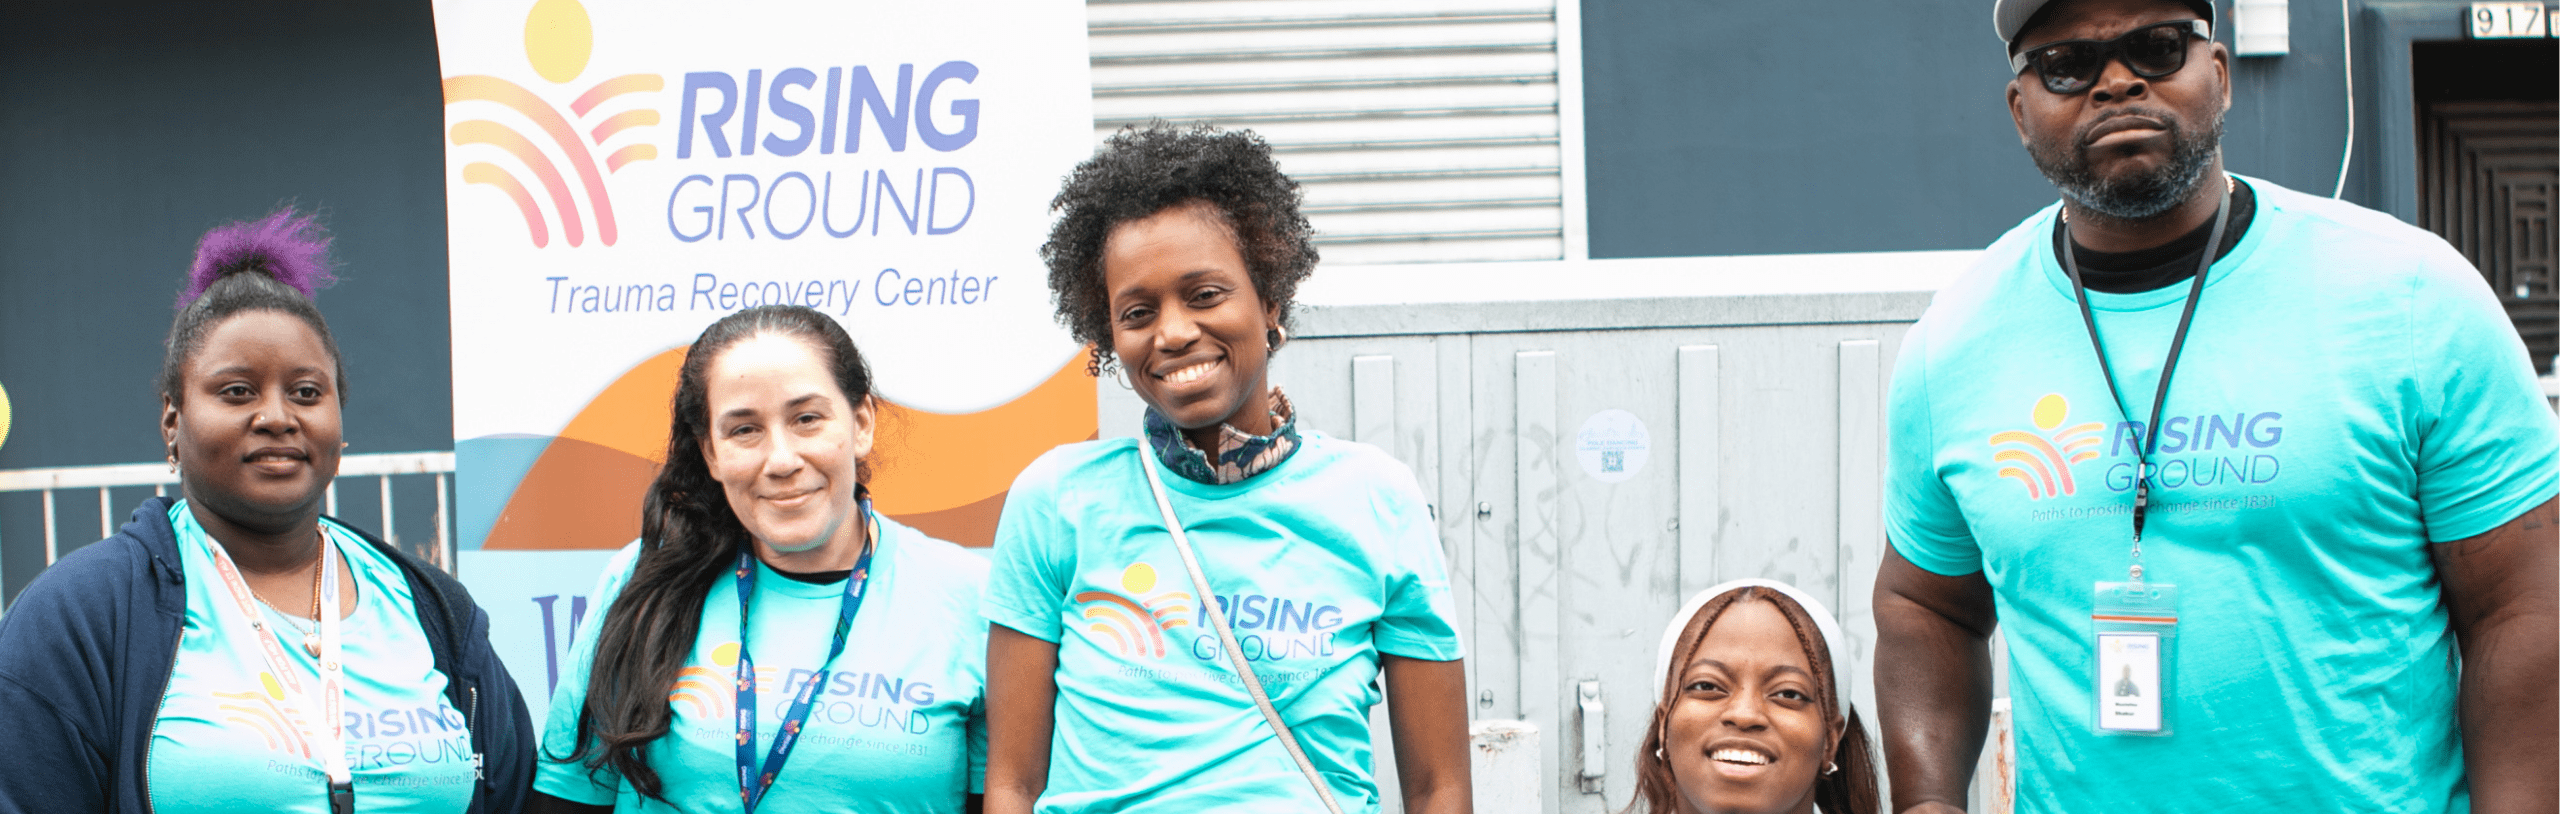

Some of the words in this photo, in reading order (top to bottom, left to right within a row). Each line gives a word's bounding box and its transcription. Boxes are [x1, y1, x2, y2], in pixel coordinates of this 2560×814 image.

[2477, 7, 2539, 34] 917
[676, 60, 980, 159] RISING
[667, 167, 975, 243] GROUND
[545, 275, 676, 313] Trauma
[690, 273, 860, 316] Recovery
[873, 268, 998, 307] Center
[2110, 412, 2283, 457] RISING
[2105, 454, 2280, 492] GROUND
[2031, 507, 2066, 522] Paths
[2069, 507, 2083, 518] to
[2086, 502, 2135, 519] positiv
[2147, 499, 2200, 515] change
[2202, 497, 2238, 511] since
[1198, 594, 1343, 634] RISING
[1193, 632, 1336, 662] GOUND
[783, 668, 935, 706] RISING
[1118, 664, 1154, 679] Paths
[1229, 670, 1274, 687] chge
[1277, 669, 1310, 683] since
[1314, 666, 1333, 680] 18
[344, 704, 463, 739] RISING
[695, 727, 731, 740] Paths
[810, 733, 863, 750] change
[866, 739, 900, 754] since
[904, 743, 928, 757] 1831
[266, 759, 303, 777] Paths
[373, 774, 429, 789] change
[433, 773, 461, 786] since
